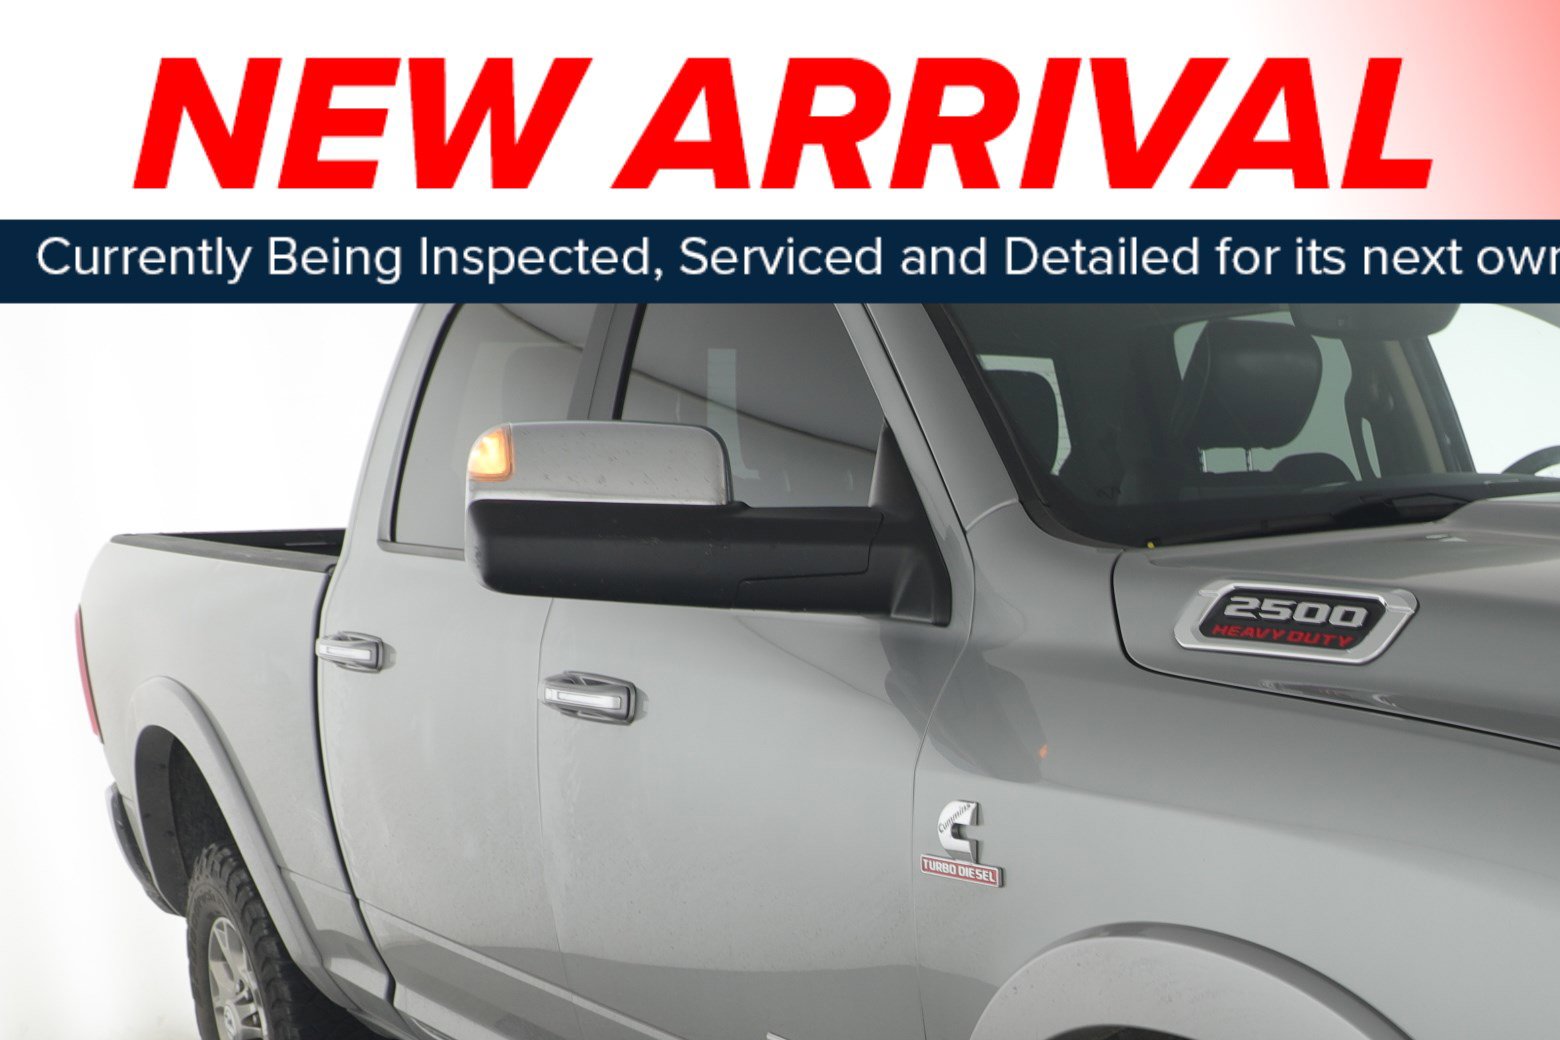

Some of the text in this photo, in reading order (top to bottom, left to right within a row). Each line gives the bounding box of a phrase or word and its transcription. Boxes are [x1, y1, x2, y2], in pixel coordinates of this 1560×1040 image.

[1224, 597, 1368, 628] 2500
[1211, 624, 1354, 648] HEAVY DUTY
[938, 802, 972, 834] Cummins
[922, 858, 997, 883] TURBO DIESEL
